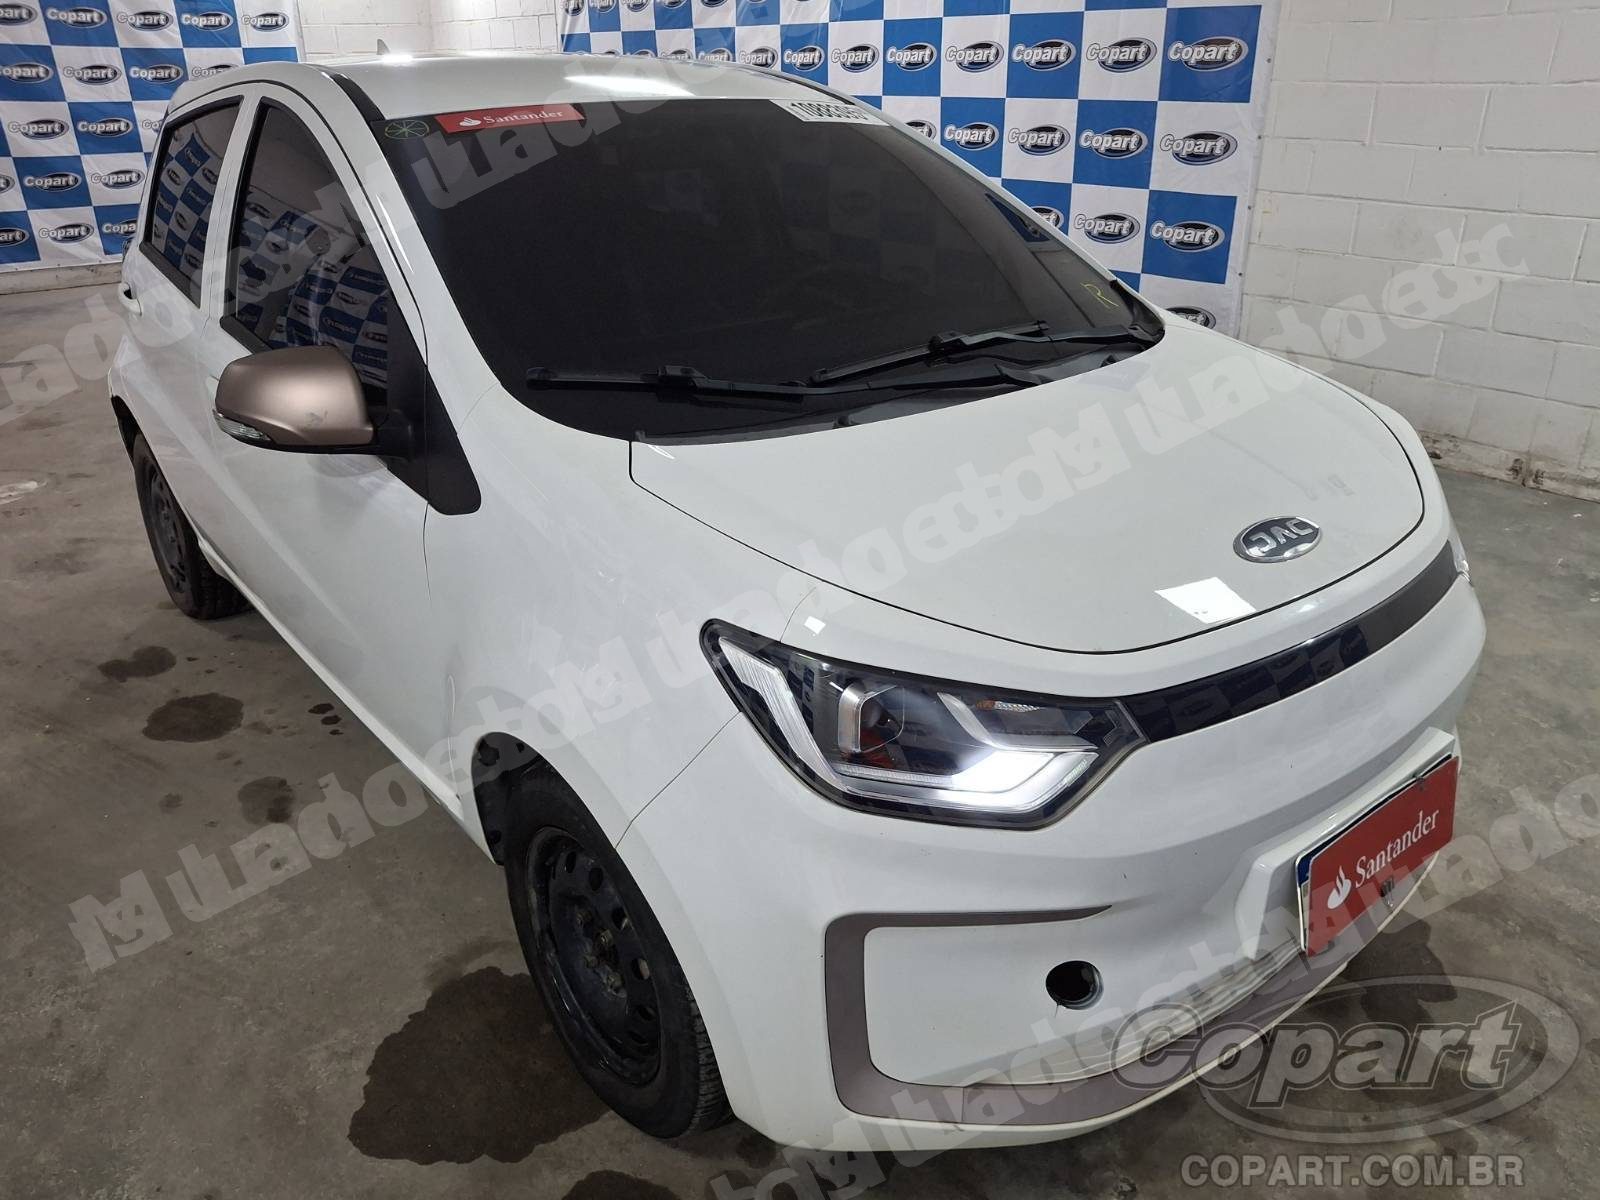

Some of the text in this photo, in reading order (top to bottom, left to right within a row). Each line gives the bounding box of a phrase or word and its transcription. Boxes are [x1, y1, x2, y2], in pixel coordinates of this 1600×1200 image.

[46, 8, 101, 24] Copart
[117, 12, 166, 27] Copart
[181, 14, 227, 27] Copart
[242, 15, 285, 28] Copart
[739, 50, 774, 65] Copart
[783, 48, 821, 66] Copart
[831, 48, 873, 66] Copart
[886, 46, 932, 65] Copart
[945, 44, 997, 66] Copart
[1012, 43, 1067, 66] Copart
[1086, 42, 1148, 64] Copart
[1168, 40, 1241, 65] Copart
[0, 66, 46, 79] opart
[63, 66, 114, 79] Copart
[130, 66, 178, 80] Copart
[483, 110, 564, 124] Santander
[8, 121, 62, 135] Copart
[78, 121, 128, 134] Copart
[944, 124, 993, 144] Copart
[1008, 127, 1062, 148] Copart
[1079, 129, 1140, 151] Copart
[1160, 133, 1227, 156] Copart
[23, 175, 76, 188] Copart
[91, 172, 139, 186] Copart
[39, 225, 87, 240] Copart
[1074, 213, 1131, 237] Copart
[1151, 220, 1216, 246] Copart
[0, 231, 22, 241] art
[1355, 809, 1439, 889] Santander
